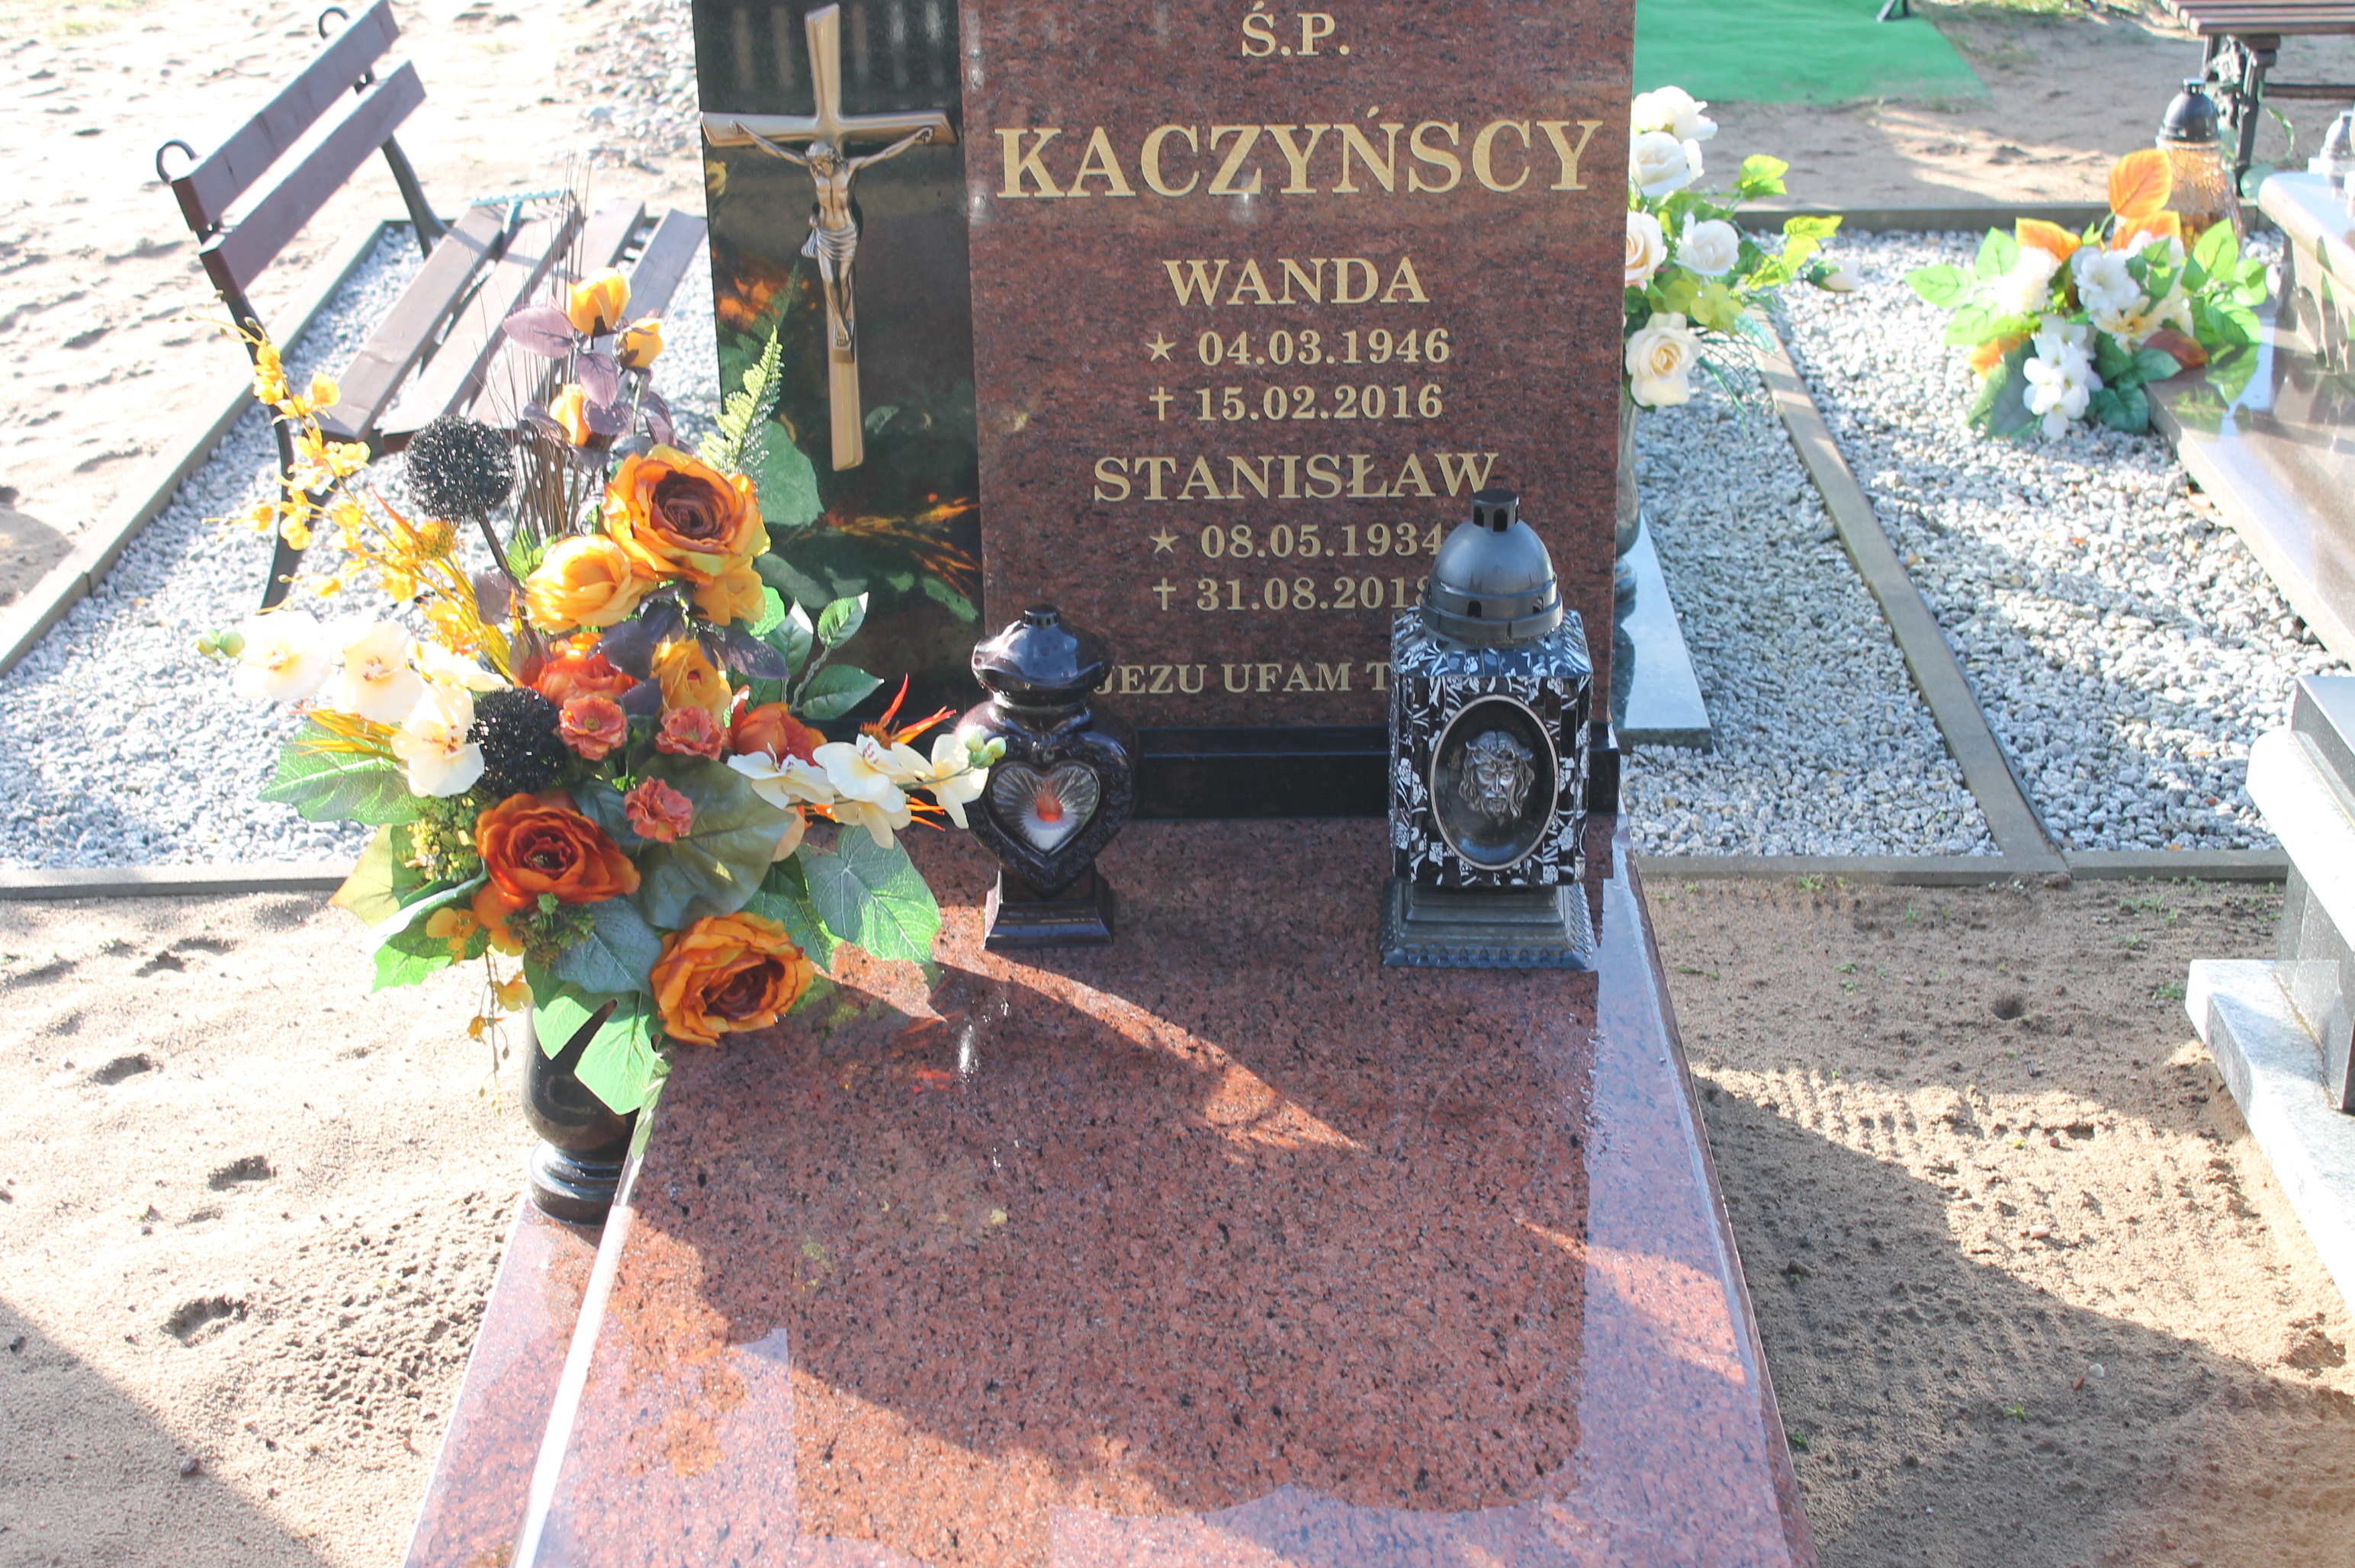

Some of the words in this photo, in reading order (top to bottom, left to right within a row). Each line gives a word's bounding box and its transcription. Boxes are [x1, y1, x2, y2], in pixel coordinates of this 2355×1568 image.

[1241, 2, 1351, 57] Ś.P.
[994, 105, 1603, 199] KACZYŃSCY
[1162, 256, 1430, 306] WANDA
[1197, 328, 1451, 367] 04.03.1946
[1196, 384, 1444, 422] 15.02.2016
[1094, 452, 1499, 503] STANISŁAW
[1201, 522, 1442, 558] 08.05.1934
[1093, 664, 1207, 695] JEZU
[1221, 662, 1353, 693] UFAM
